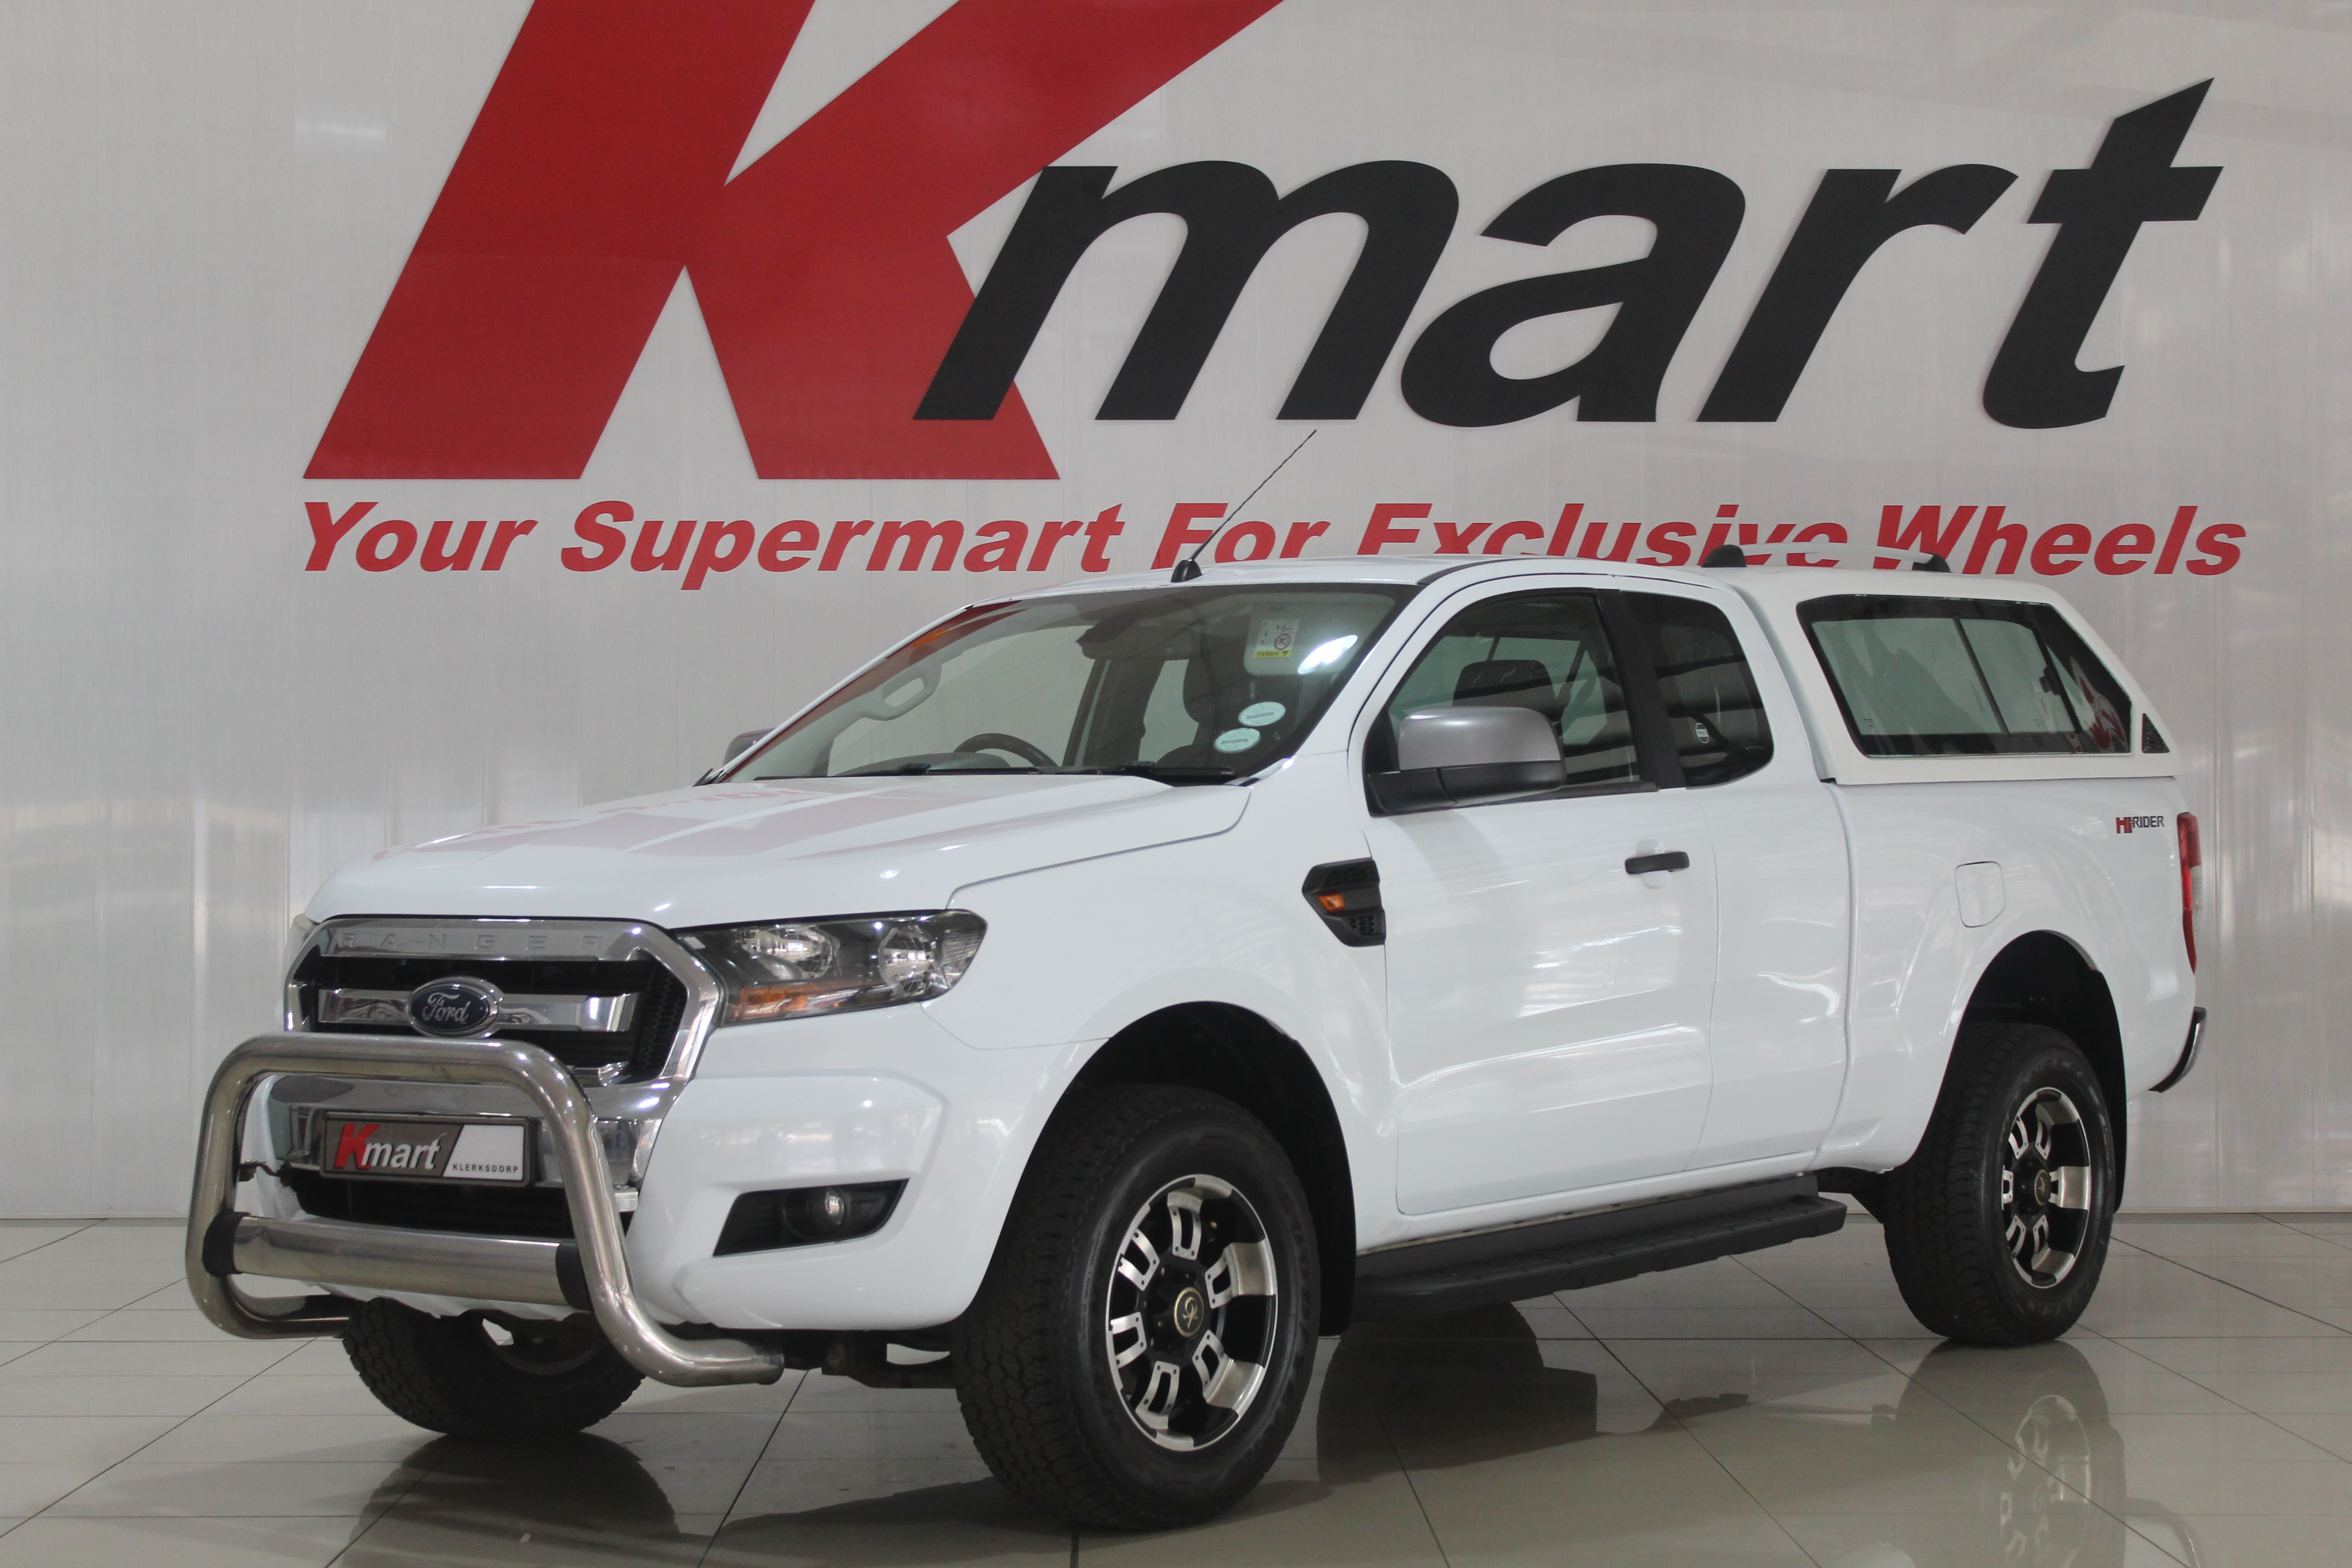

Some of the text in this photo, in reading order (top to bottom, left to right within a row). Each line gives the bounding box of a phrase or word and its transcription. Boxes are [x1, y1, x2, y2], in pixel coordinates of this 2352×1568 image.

[304, 0, 2223, 480] Kmart
[305, 501, 2246, 590] Your Supermart For Exclusive Wheels
[340, 932, 603, 951] RANGER
[421, 992, 472, 1024] Ford
[333, 1122, 519, 1173] Kmart KLERKSDORP
